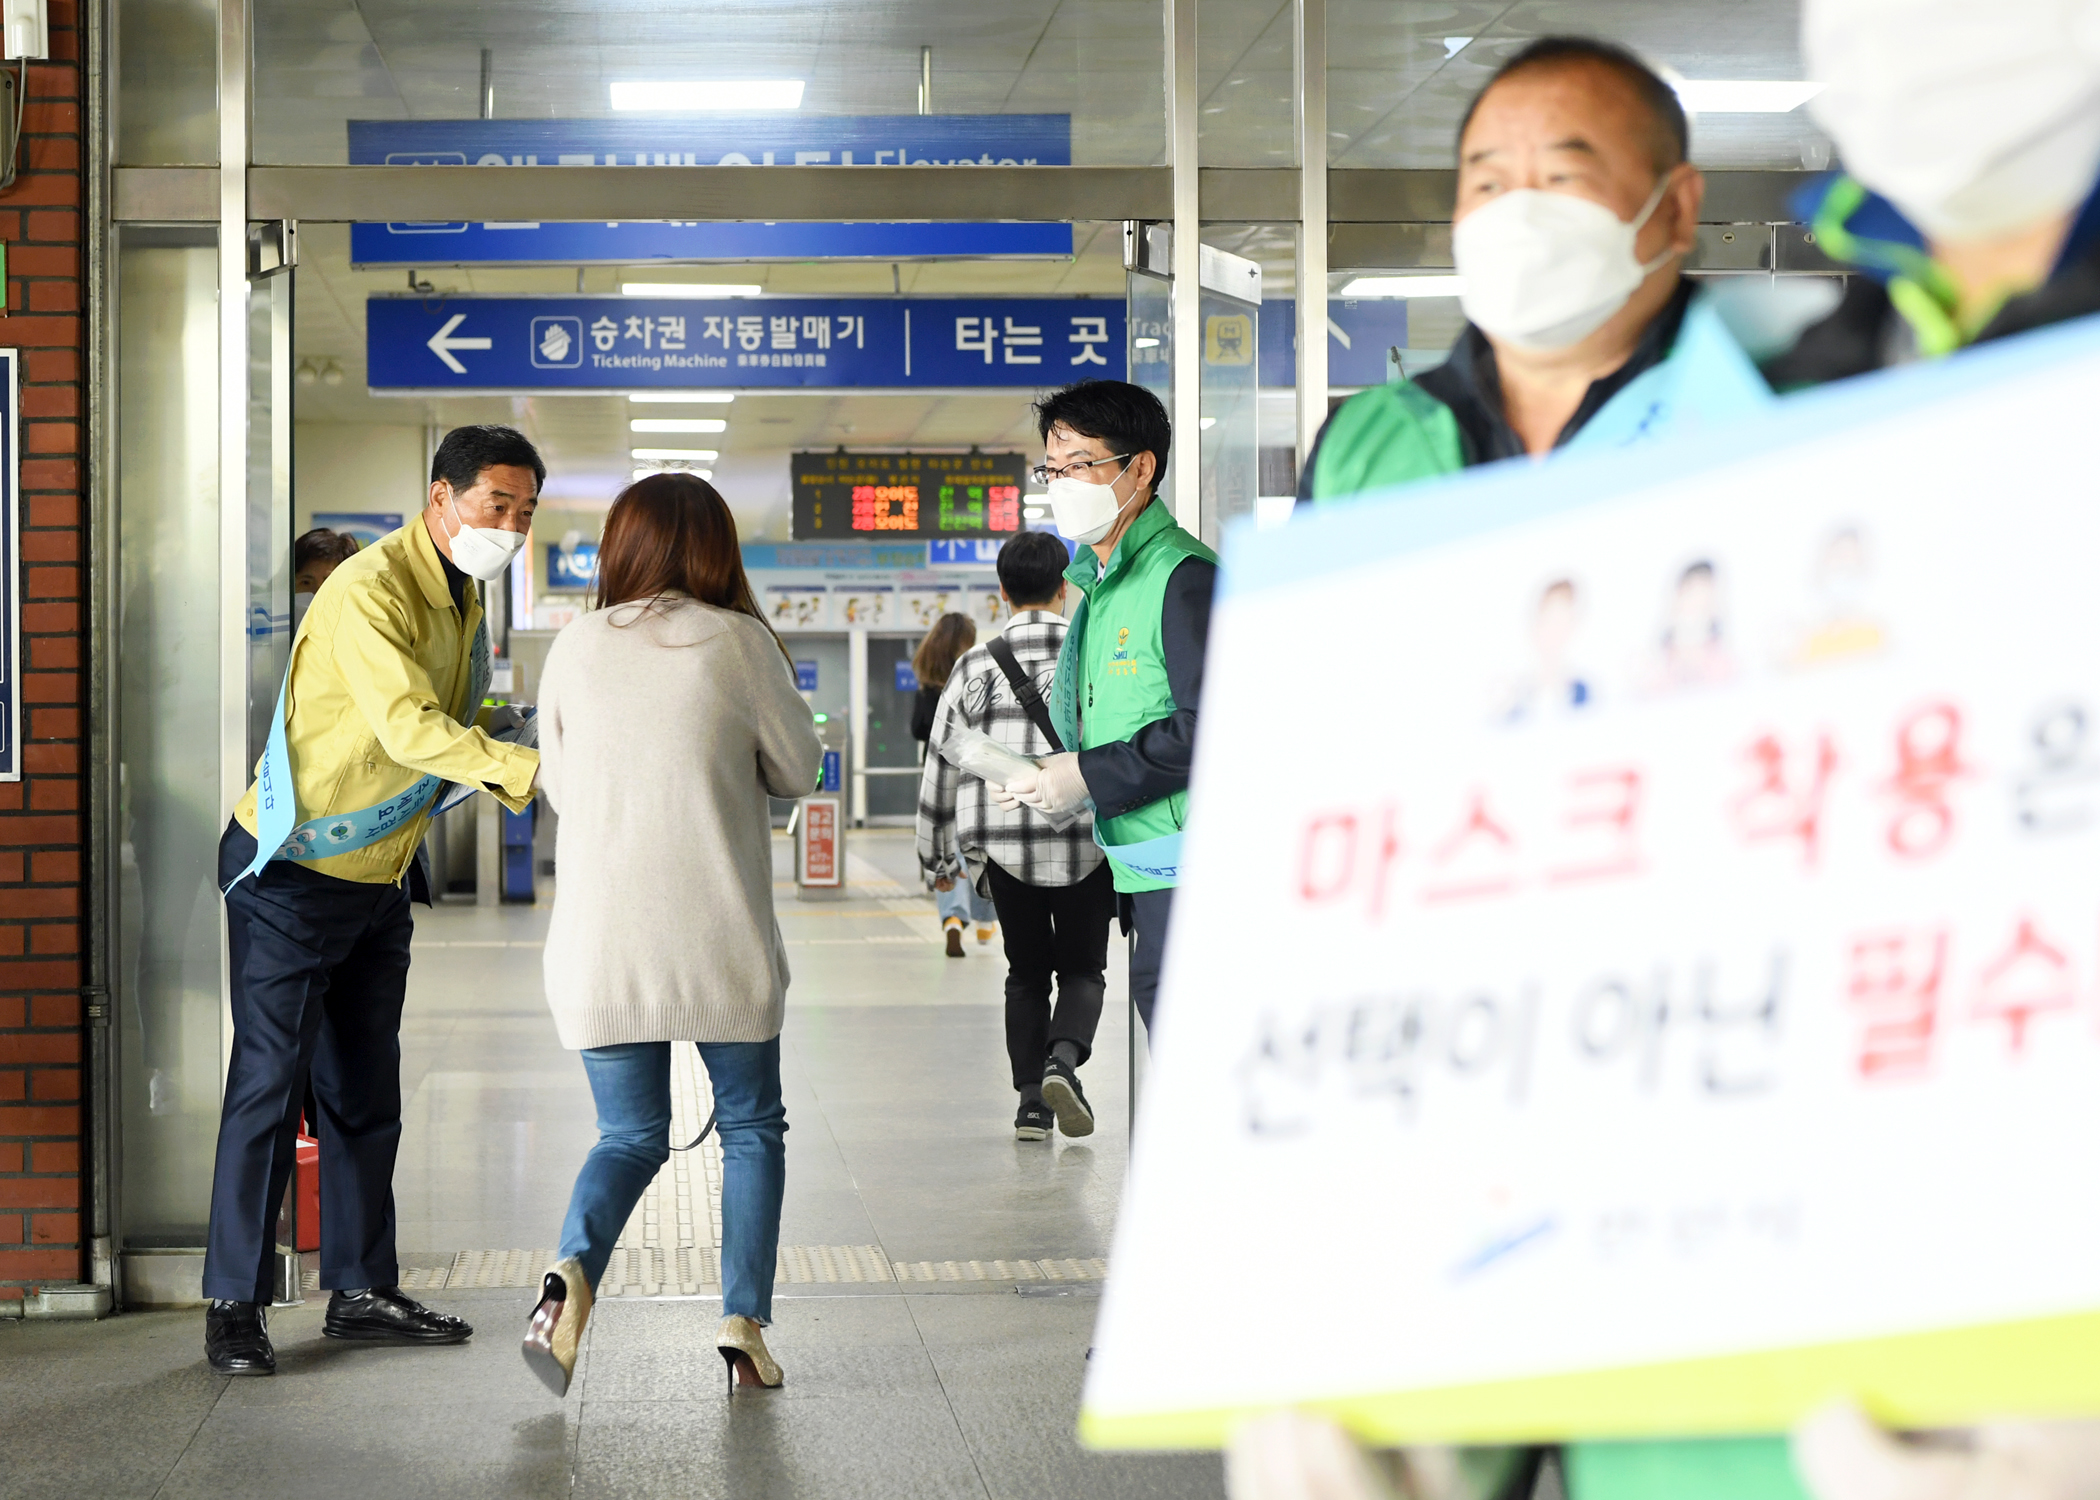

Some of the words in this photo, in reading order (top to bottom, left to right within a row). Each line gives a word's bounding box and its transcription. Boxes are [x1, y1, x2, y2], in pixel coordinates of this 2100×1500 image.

[590, 316, 686, 351] 승차권
[703, 316, 864, 351] 자동발매기
[955, 316, 1043, 365] 타는
[1068, 317, 1109, 366] 곳
[591, 354, 662, 371] Ticketing
[664, 354, 728, 368] Machine
[1296, 763, 1650, 922] 마스크
[1236, 974, 1544, 1138] 선택이
[1572, 942, 1796, 1099] 아닌
[1841, 912, 2100, 1085] 필수
